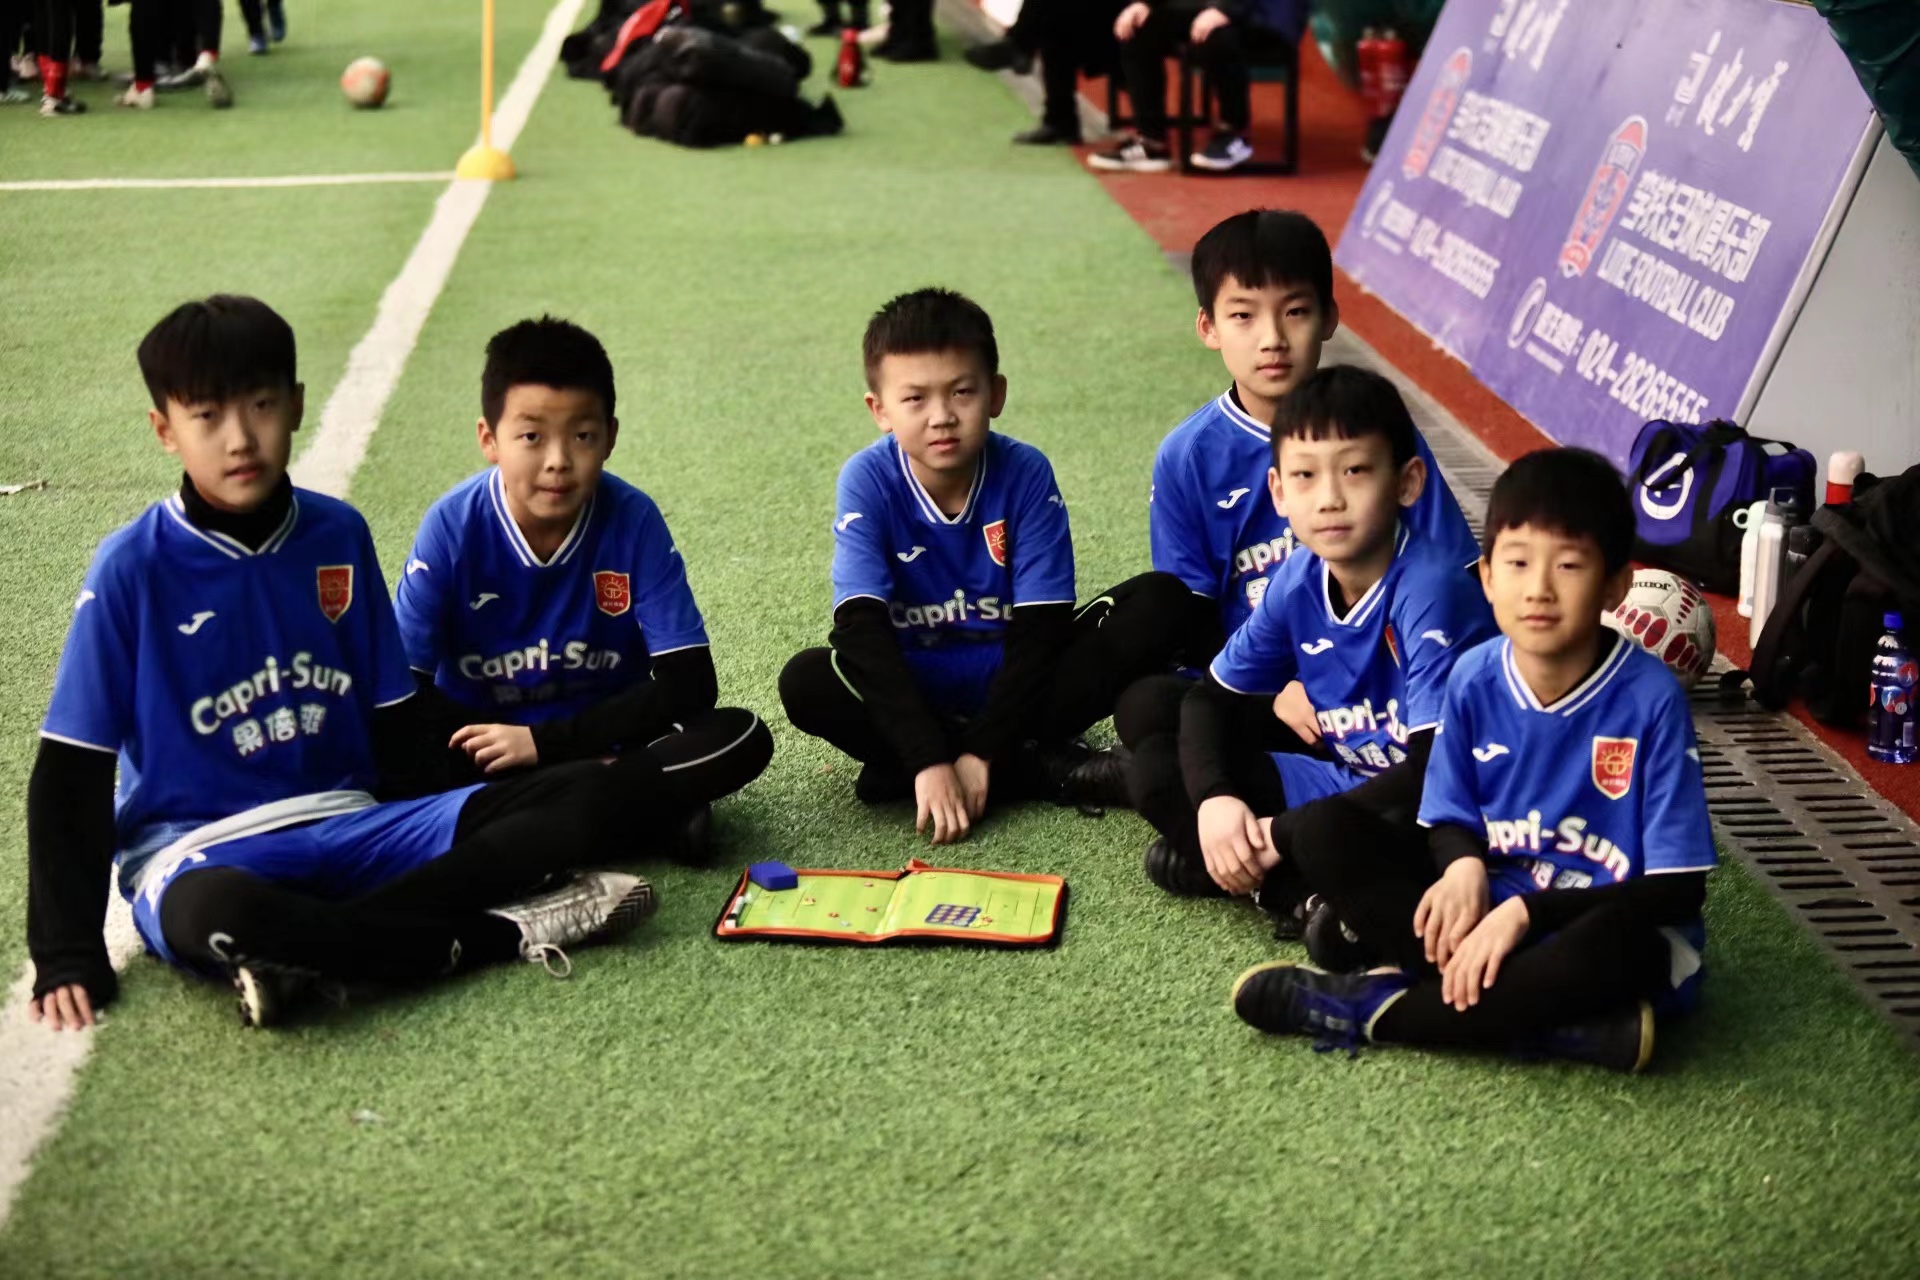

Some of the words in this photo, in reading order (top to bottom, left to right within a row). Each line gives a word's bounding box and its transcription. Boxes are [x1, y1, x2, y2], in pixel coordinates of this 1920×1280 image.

[1687, 286, 1735, 341] CLUB
[890, 589, 1013, 628] Capri-Su
[459, 638, 621, 679] Capri-Sun
[190, 651, 352, 735] Capri-Sun
[1483, 810, 1630, 881] apri-Sun
